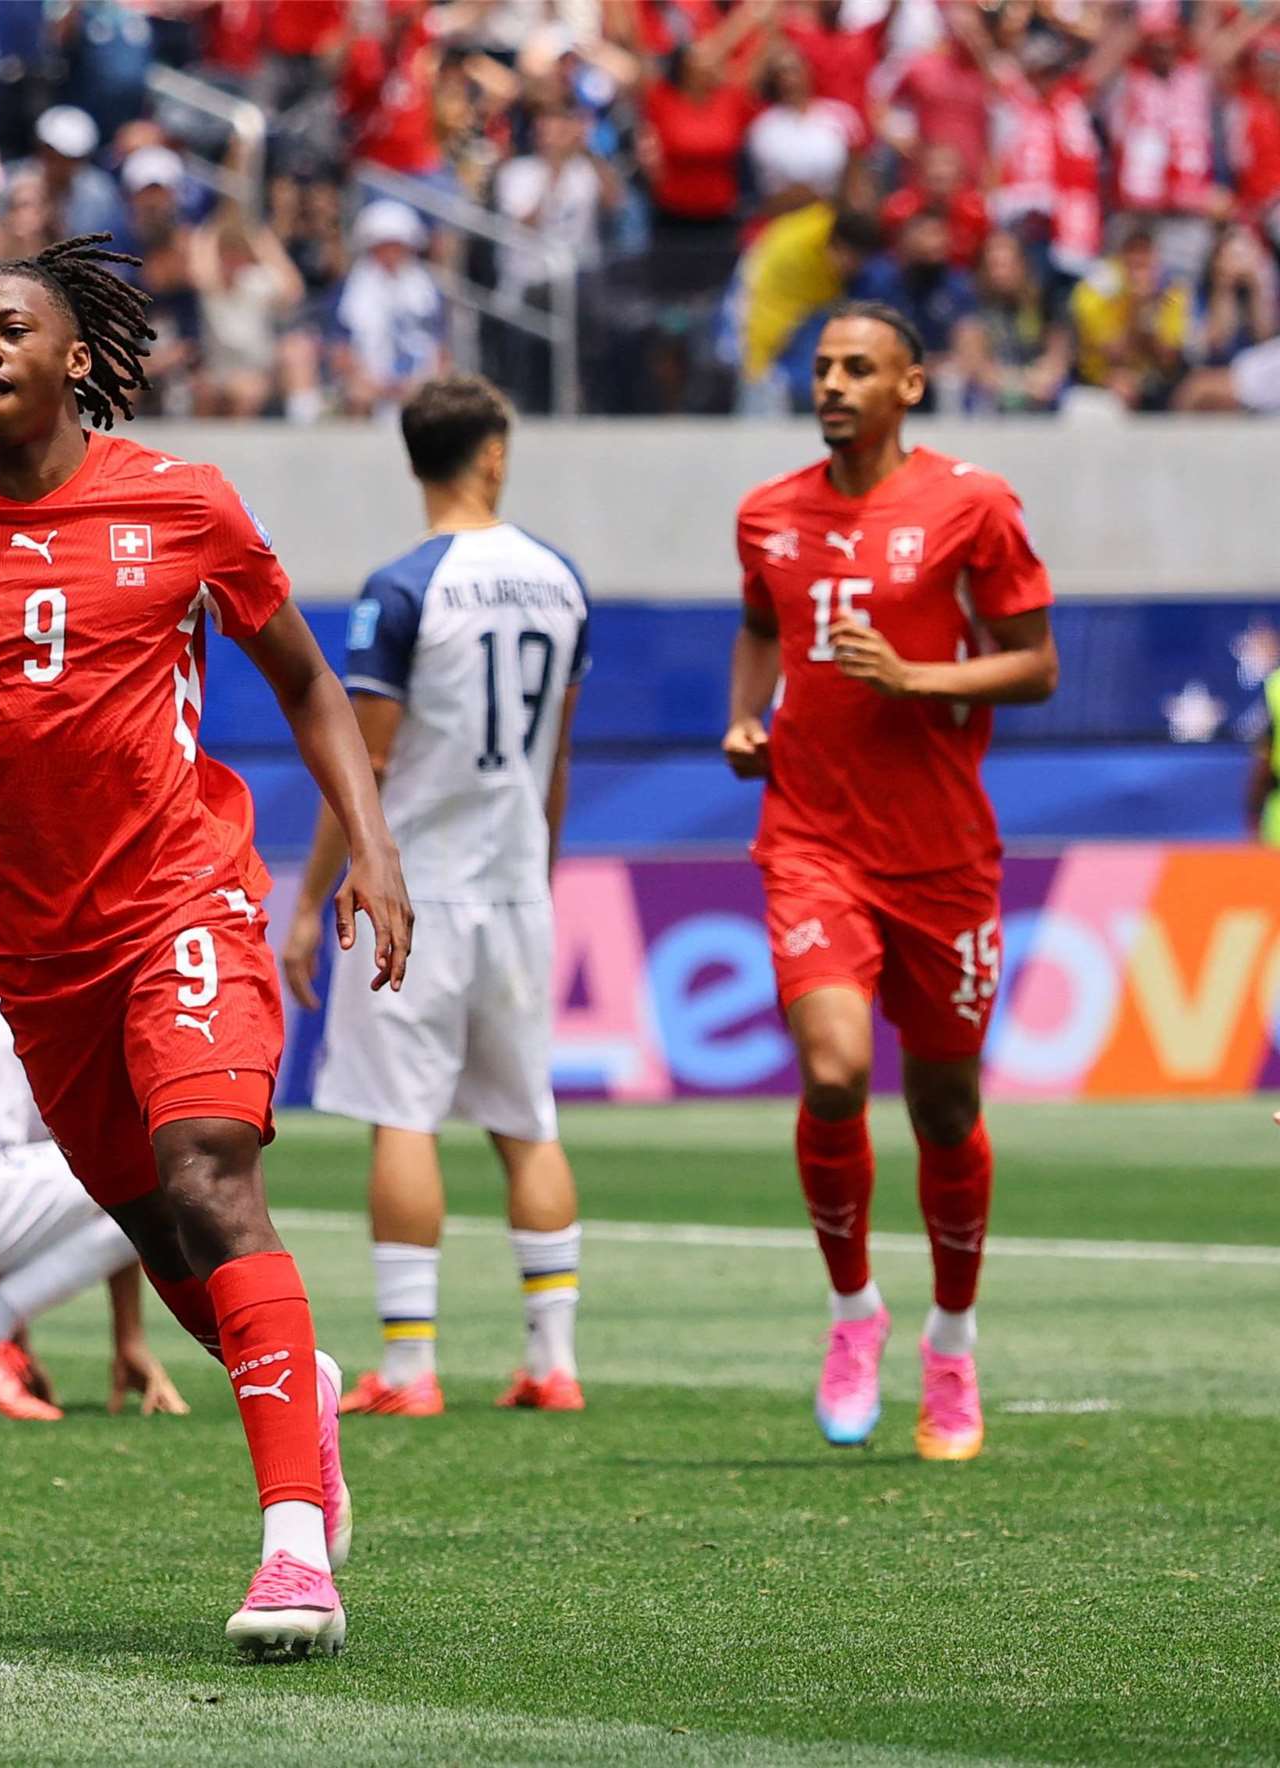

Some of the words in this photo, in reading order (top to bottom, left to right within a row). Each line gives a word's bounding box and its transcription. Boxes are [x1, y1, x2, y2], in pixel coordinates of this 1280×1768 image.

[23, 587, 68, 683] 9
[477, 630, 554, 769] 19
[174, 927, 218, 1007] 9
[950, 919, 999, 1003] 15
[230, 1350, 290, 1380] suisse
